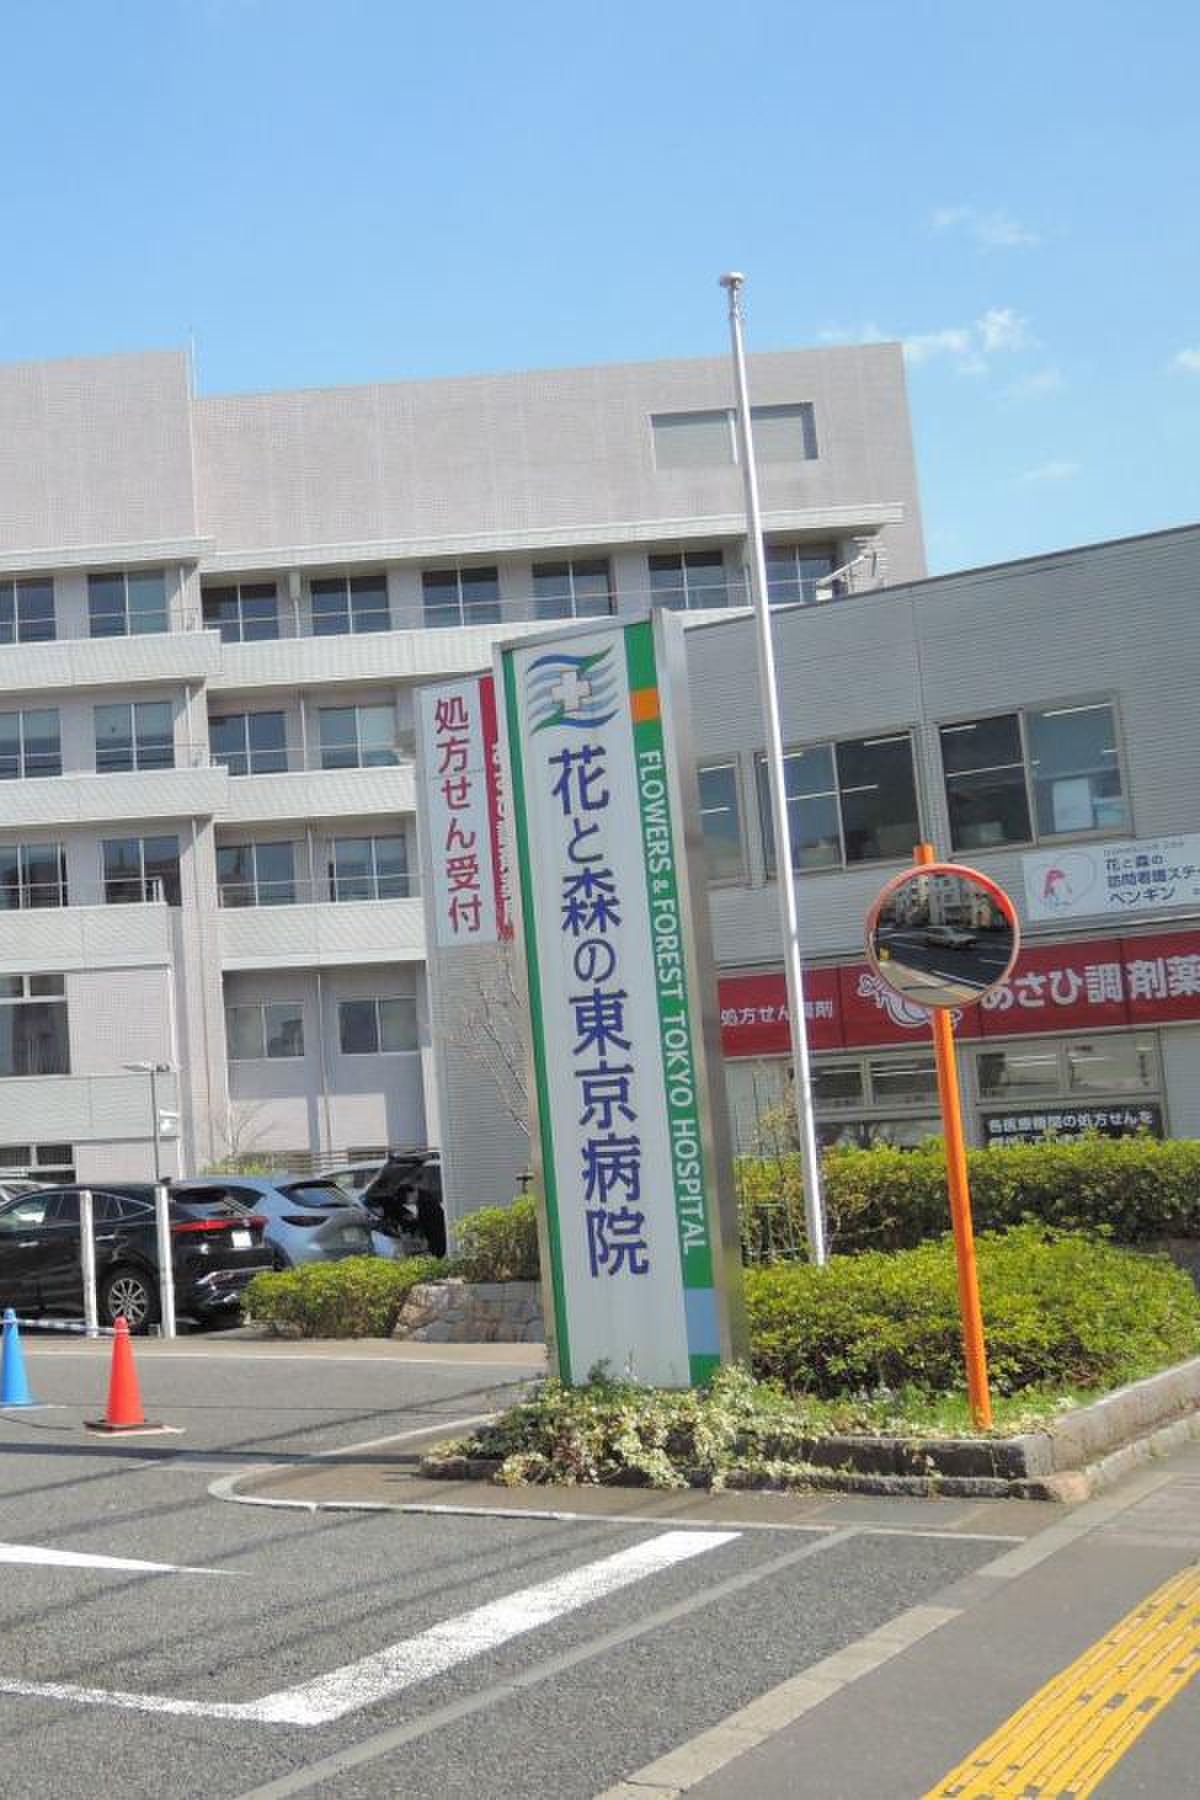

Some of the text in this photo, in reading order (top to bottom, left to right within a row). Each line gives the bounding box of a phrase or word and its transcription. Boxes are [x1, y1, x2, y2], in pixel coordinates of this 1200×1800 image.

[435, 696, 483, 934] 処方せん受付
[547, 744, 649, 1278] 花と森の東京病院
[640, 751, 706, 1255] FLOWERS & FOREST TOKYO HOSPITAL
